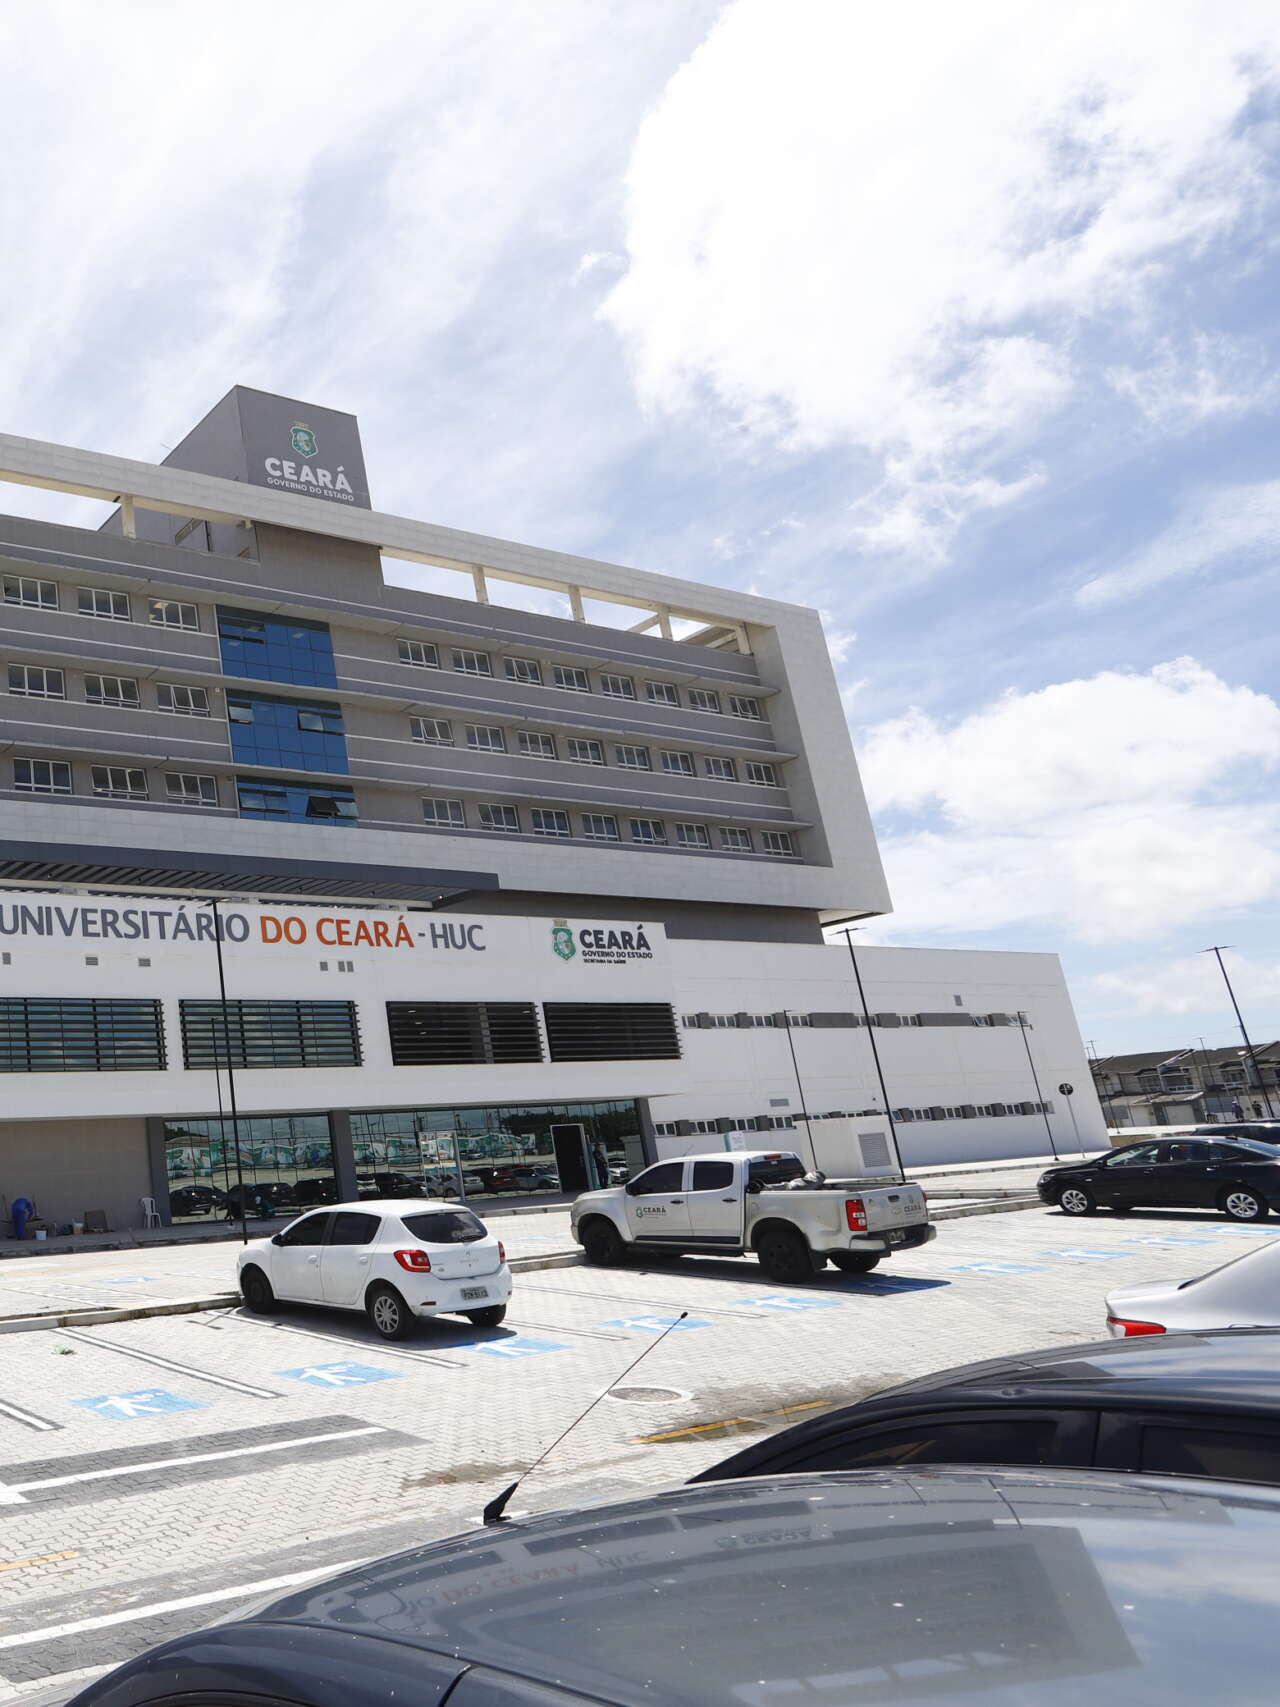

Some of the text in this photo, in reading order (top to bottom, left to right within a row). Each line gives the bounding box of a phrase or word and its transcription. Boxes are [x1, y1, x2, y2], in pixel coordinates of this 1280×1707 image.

[265, 457, 353, 494] CEARÁ
[267, 477, 354, 502] GOVERNO DO ESTADO
[260, 914, 307, 945] DO
[316, 914, 415, 949] CEARÁ
[580, 923, 651, 951] CEARÁ
[582, 950, 653, 960] GOVERNO DO ESTADO
